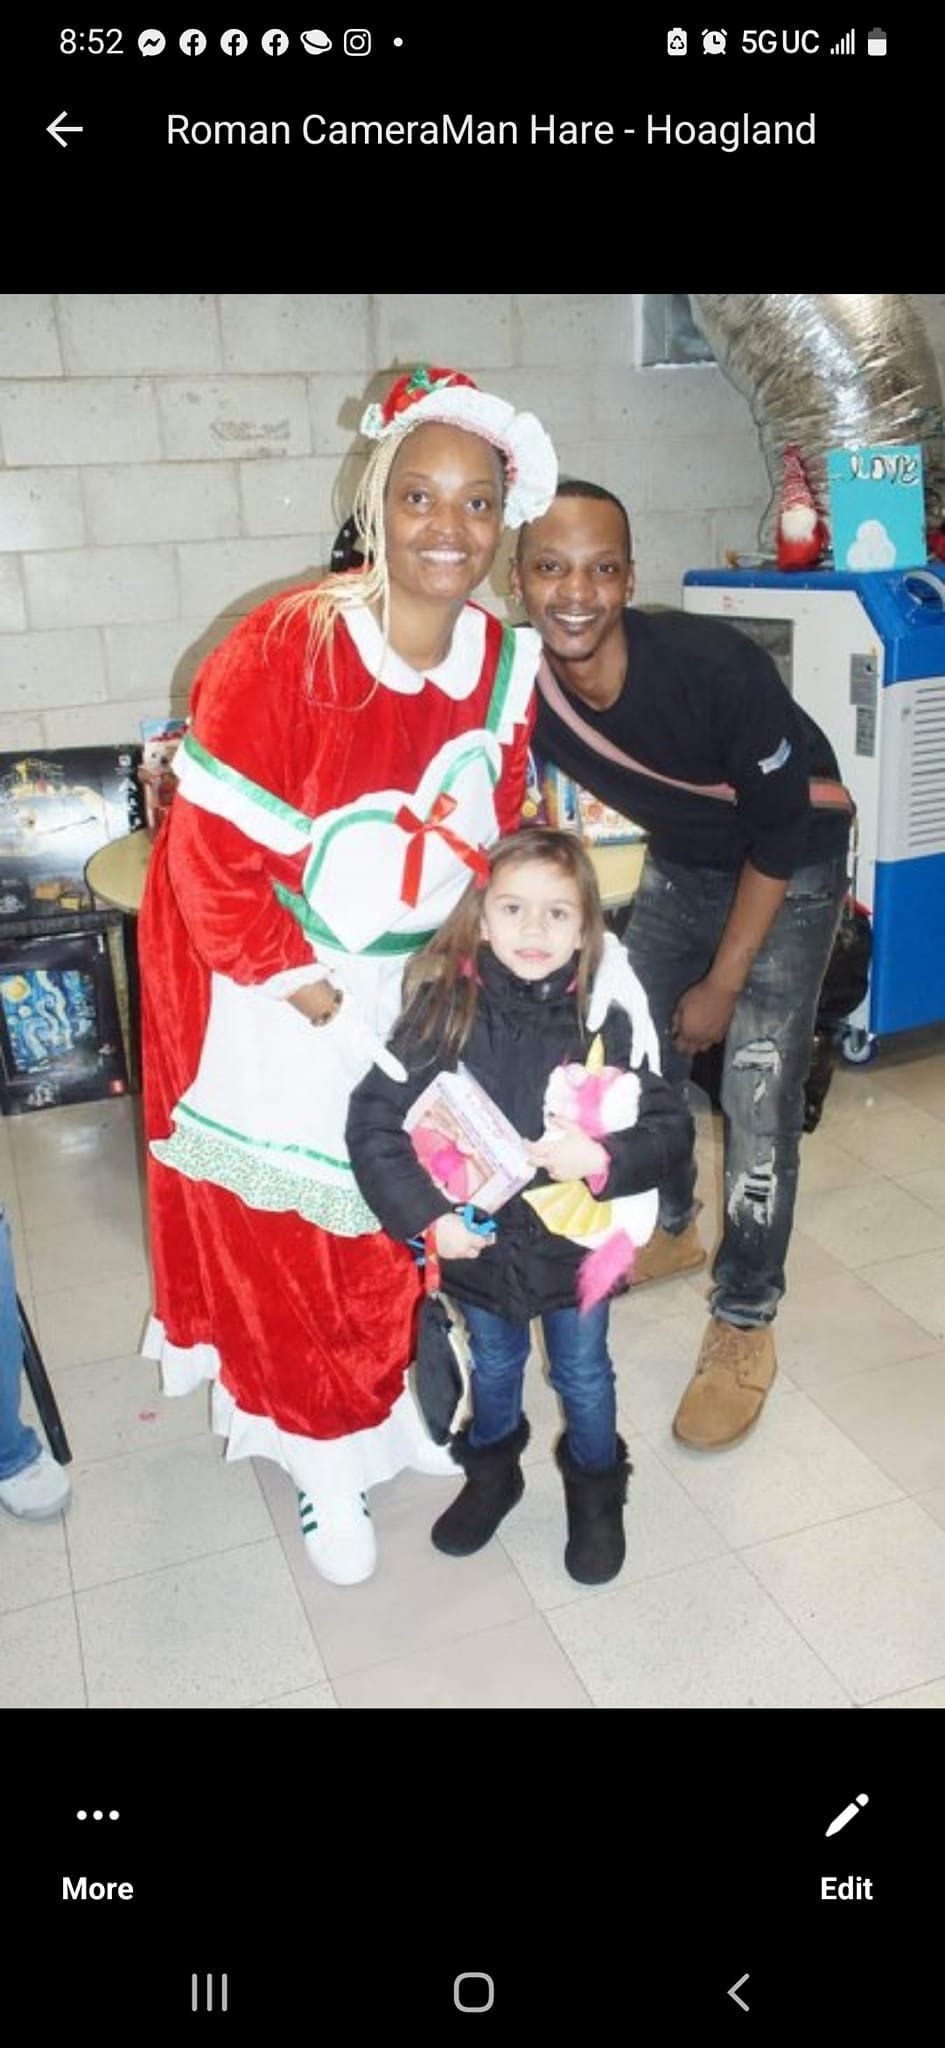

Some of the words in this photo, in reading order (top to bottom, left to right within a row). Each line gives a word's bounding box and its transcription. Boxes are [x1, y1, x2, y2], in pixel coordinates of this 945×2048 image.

[59, 28, 124, 55] 8:52
[167, 114, 290, 145] Roman
[302, 113, 518, 145] CameraMan
[531, 114, 614, 145] Hare
[647, 112, 816, 153] Hoagland
[62, 1876, 134, 1901] More
[820, 1875, 874, 1901] Edit
